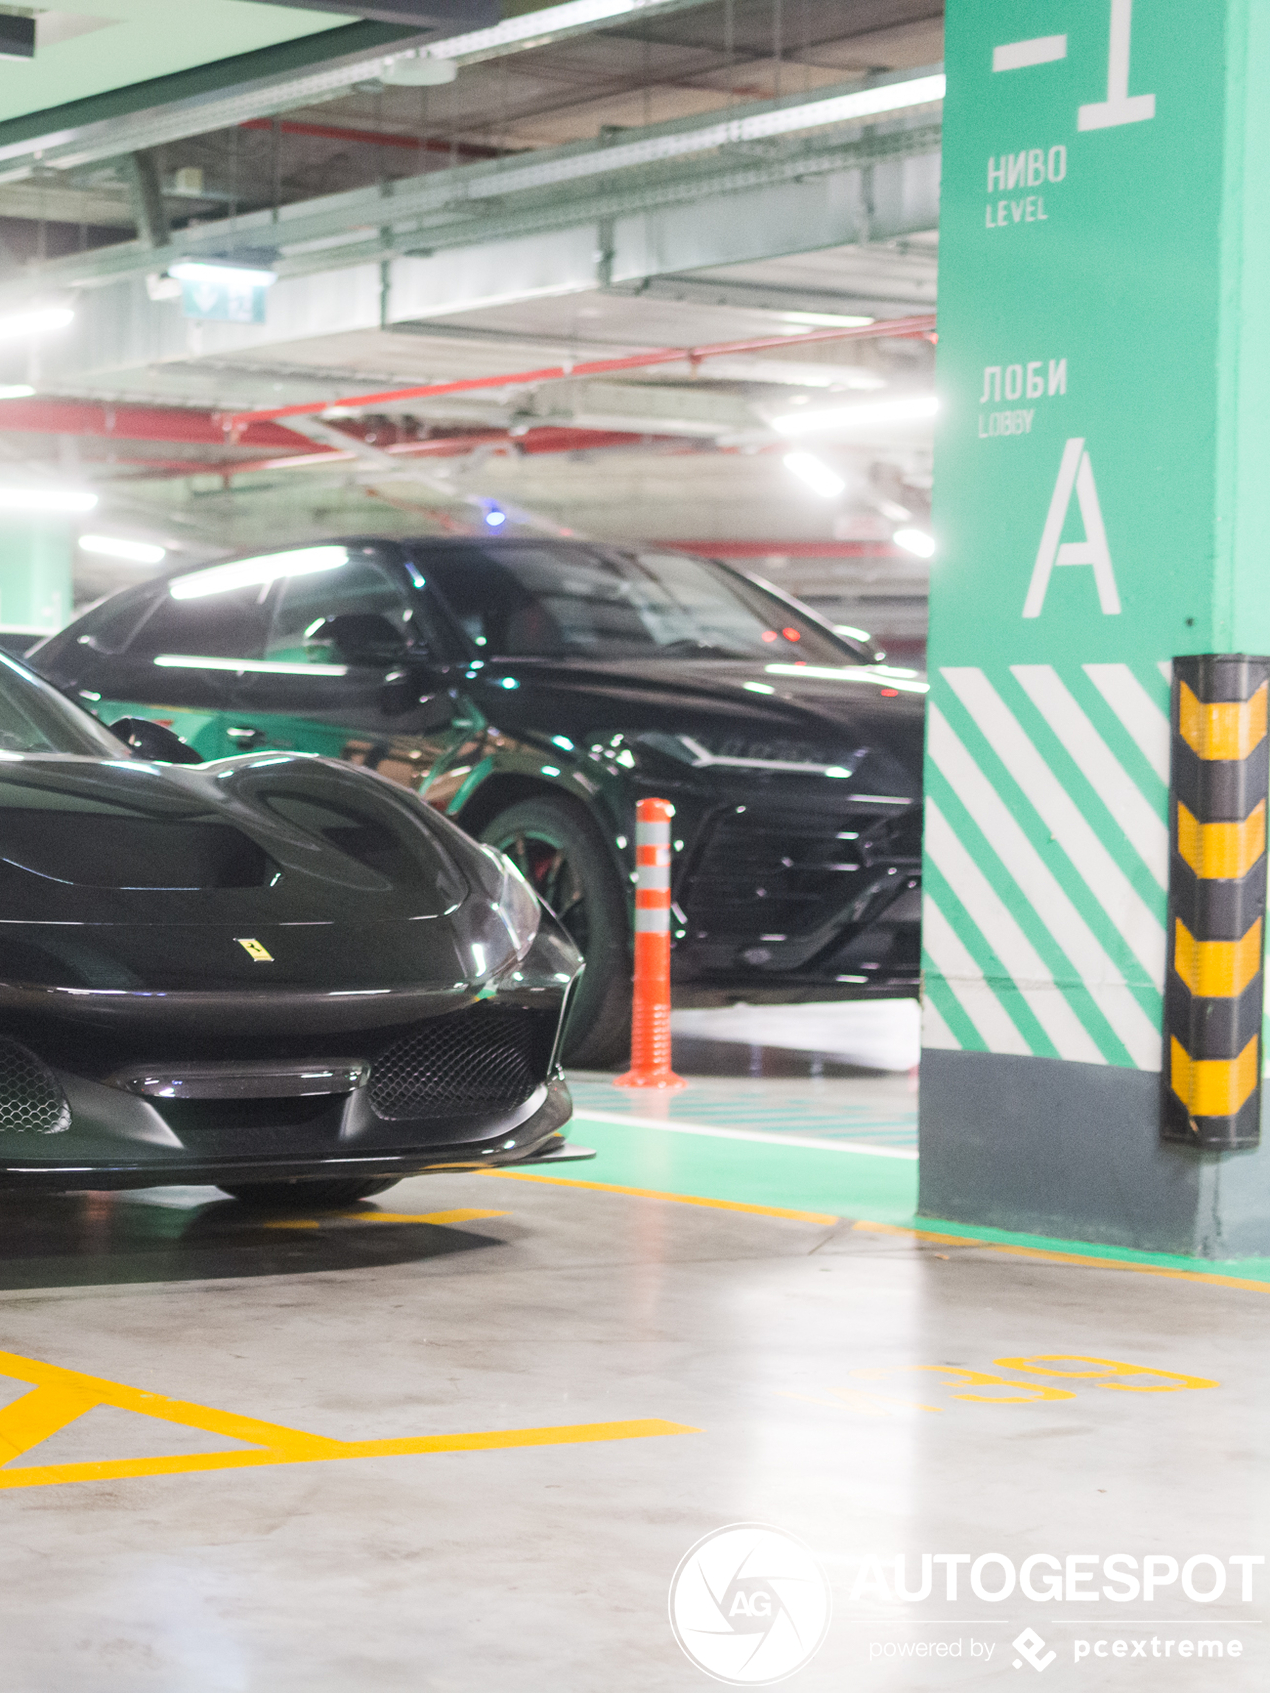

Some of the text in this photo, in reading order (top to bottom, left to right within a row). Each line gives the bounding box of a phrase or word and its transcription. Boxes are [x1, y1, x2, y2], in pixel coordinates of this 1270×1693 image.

[991, 0, 1156, 132] -1
[987, 145, 1067, 192] НИВО
[985, 196, 1048, 228] LEVEL
[981, 358, 1067, 404] ЛОБИ
[978, 408, 1035, 438] LOBBY
[1022, 437, 1122, 618] A
